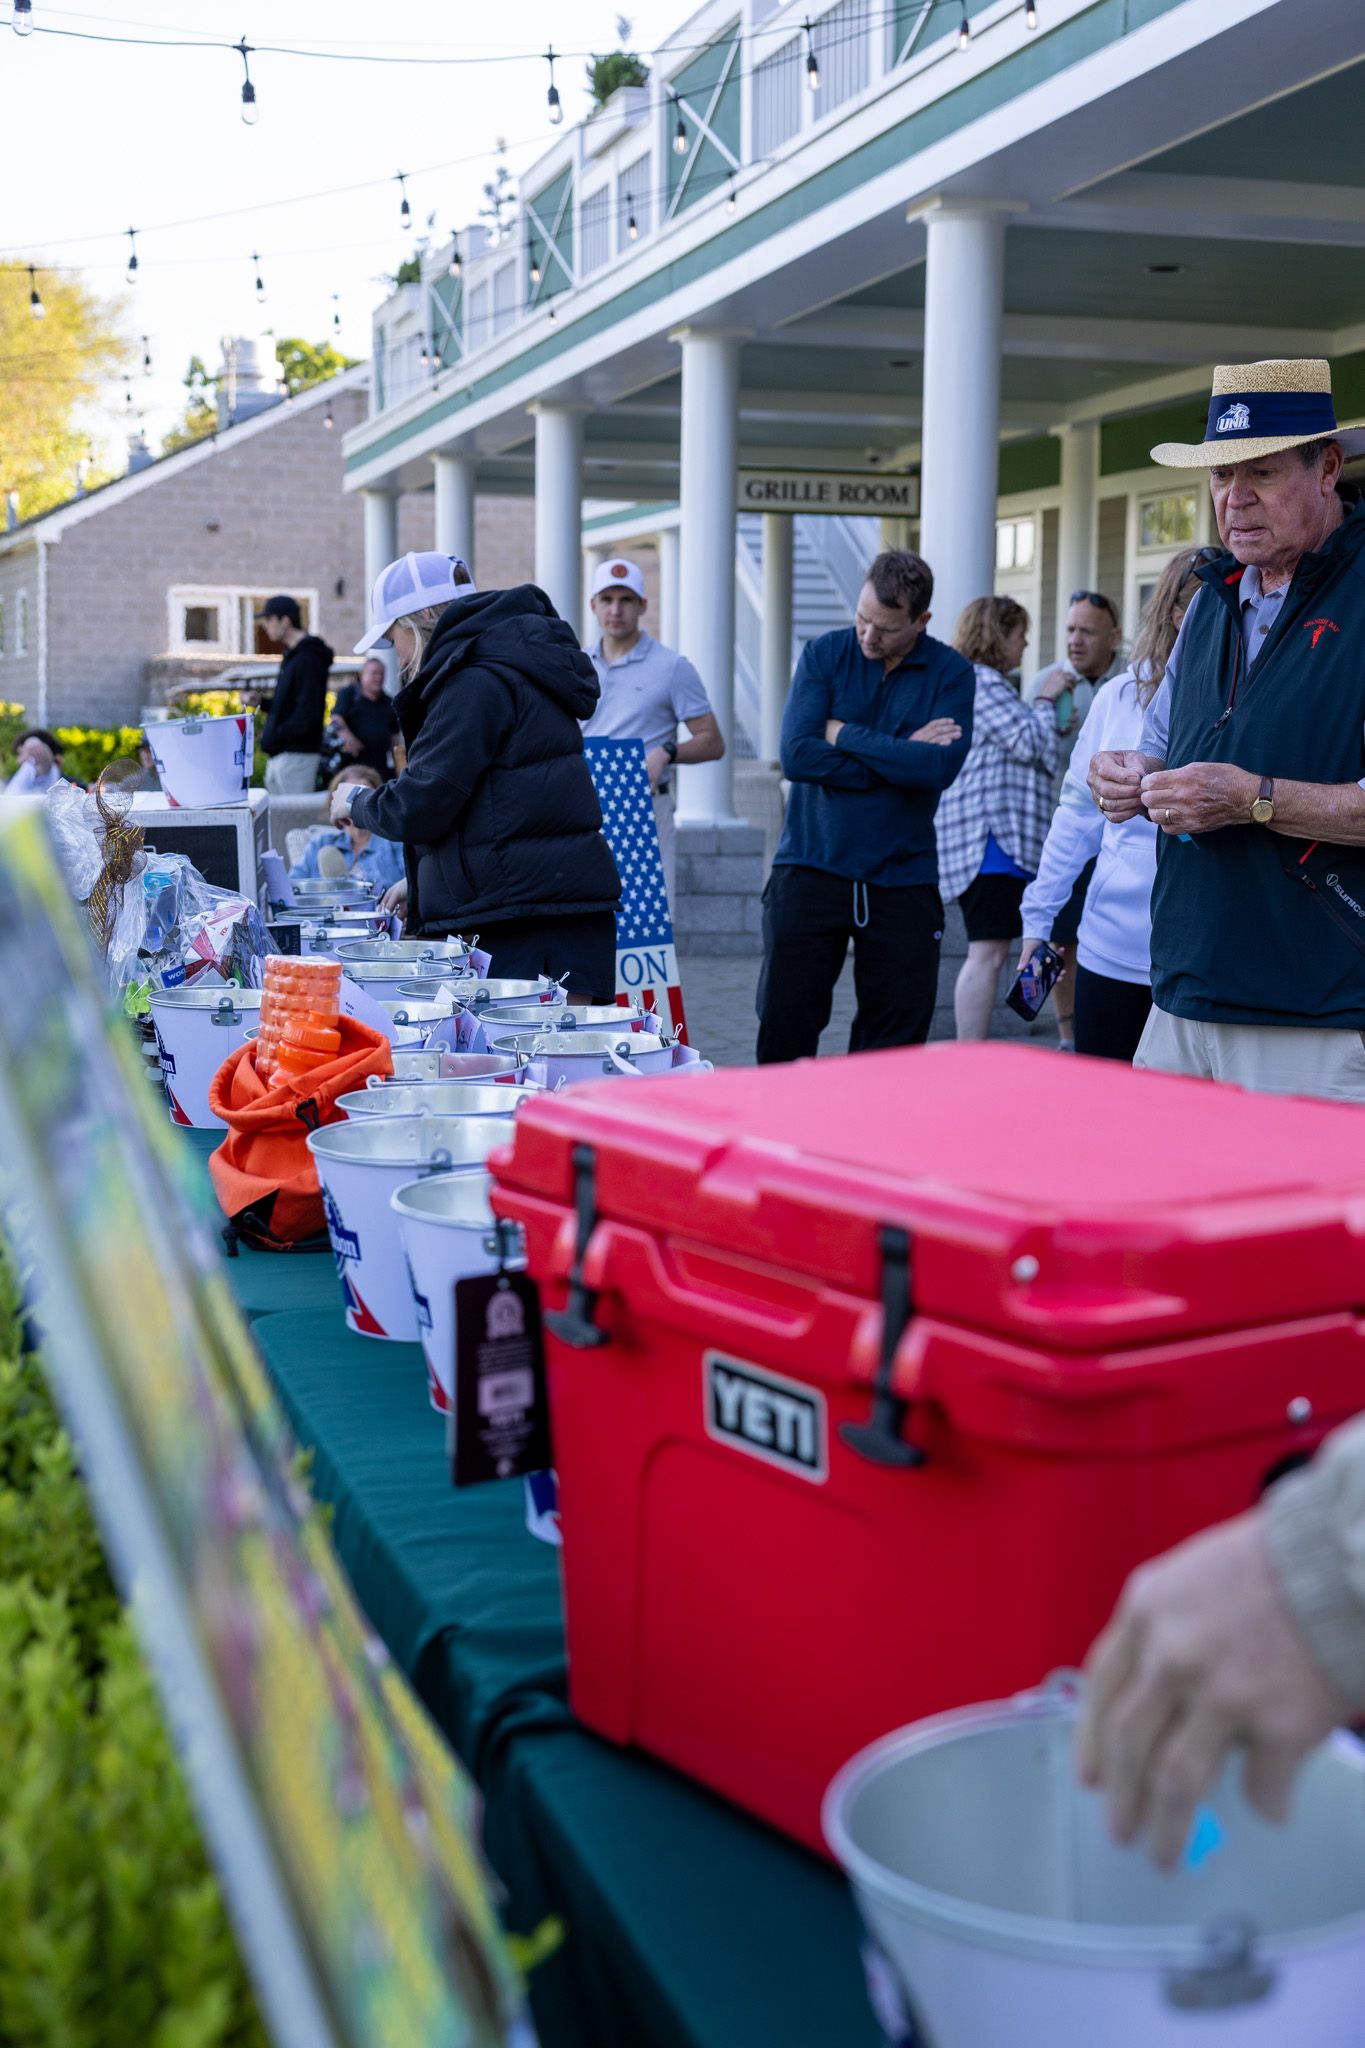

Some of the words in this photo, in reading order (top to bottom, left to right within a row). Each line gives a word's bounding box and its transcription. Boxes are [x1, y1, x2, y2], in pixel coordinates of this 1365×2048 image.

[1219, 417, 1247, 430] UNH
[745, 479, 831, 502] GRILLE
[838, 482, 909, 505] ROOM
[620, 950, 668, 986] ON
[714, 1369, 815, 1462] YETI
